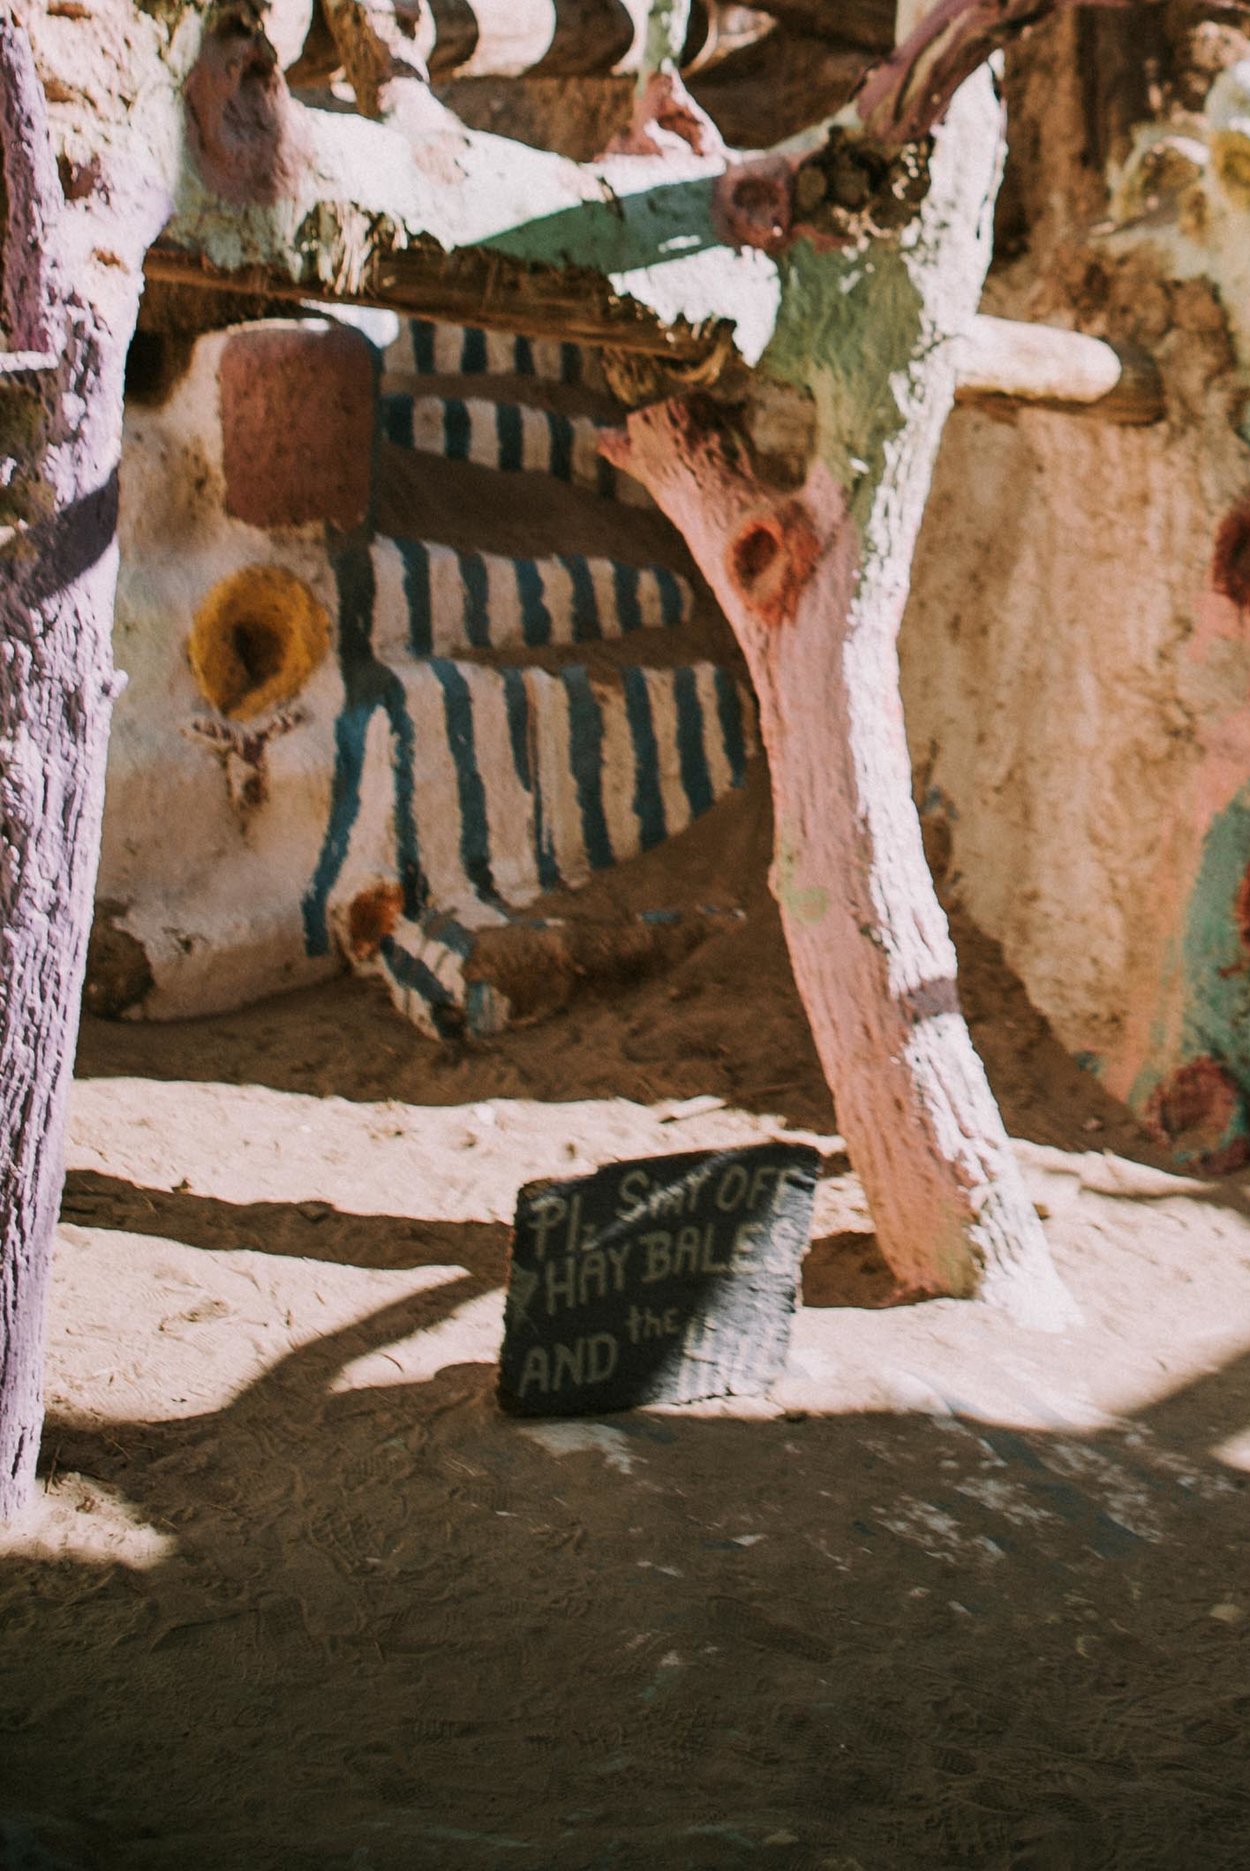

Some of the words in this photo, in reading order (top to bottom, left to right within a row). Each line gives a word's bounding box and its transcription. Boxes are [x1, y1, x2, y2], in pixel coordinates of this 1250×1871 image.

[716, 1165, 804, 1214] OFF
[544, 1240, 631, 1315] HAY
[639, 1218, 803, 1282] BALES
[517, 1332, 618, 1398] AND
